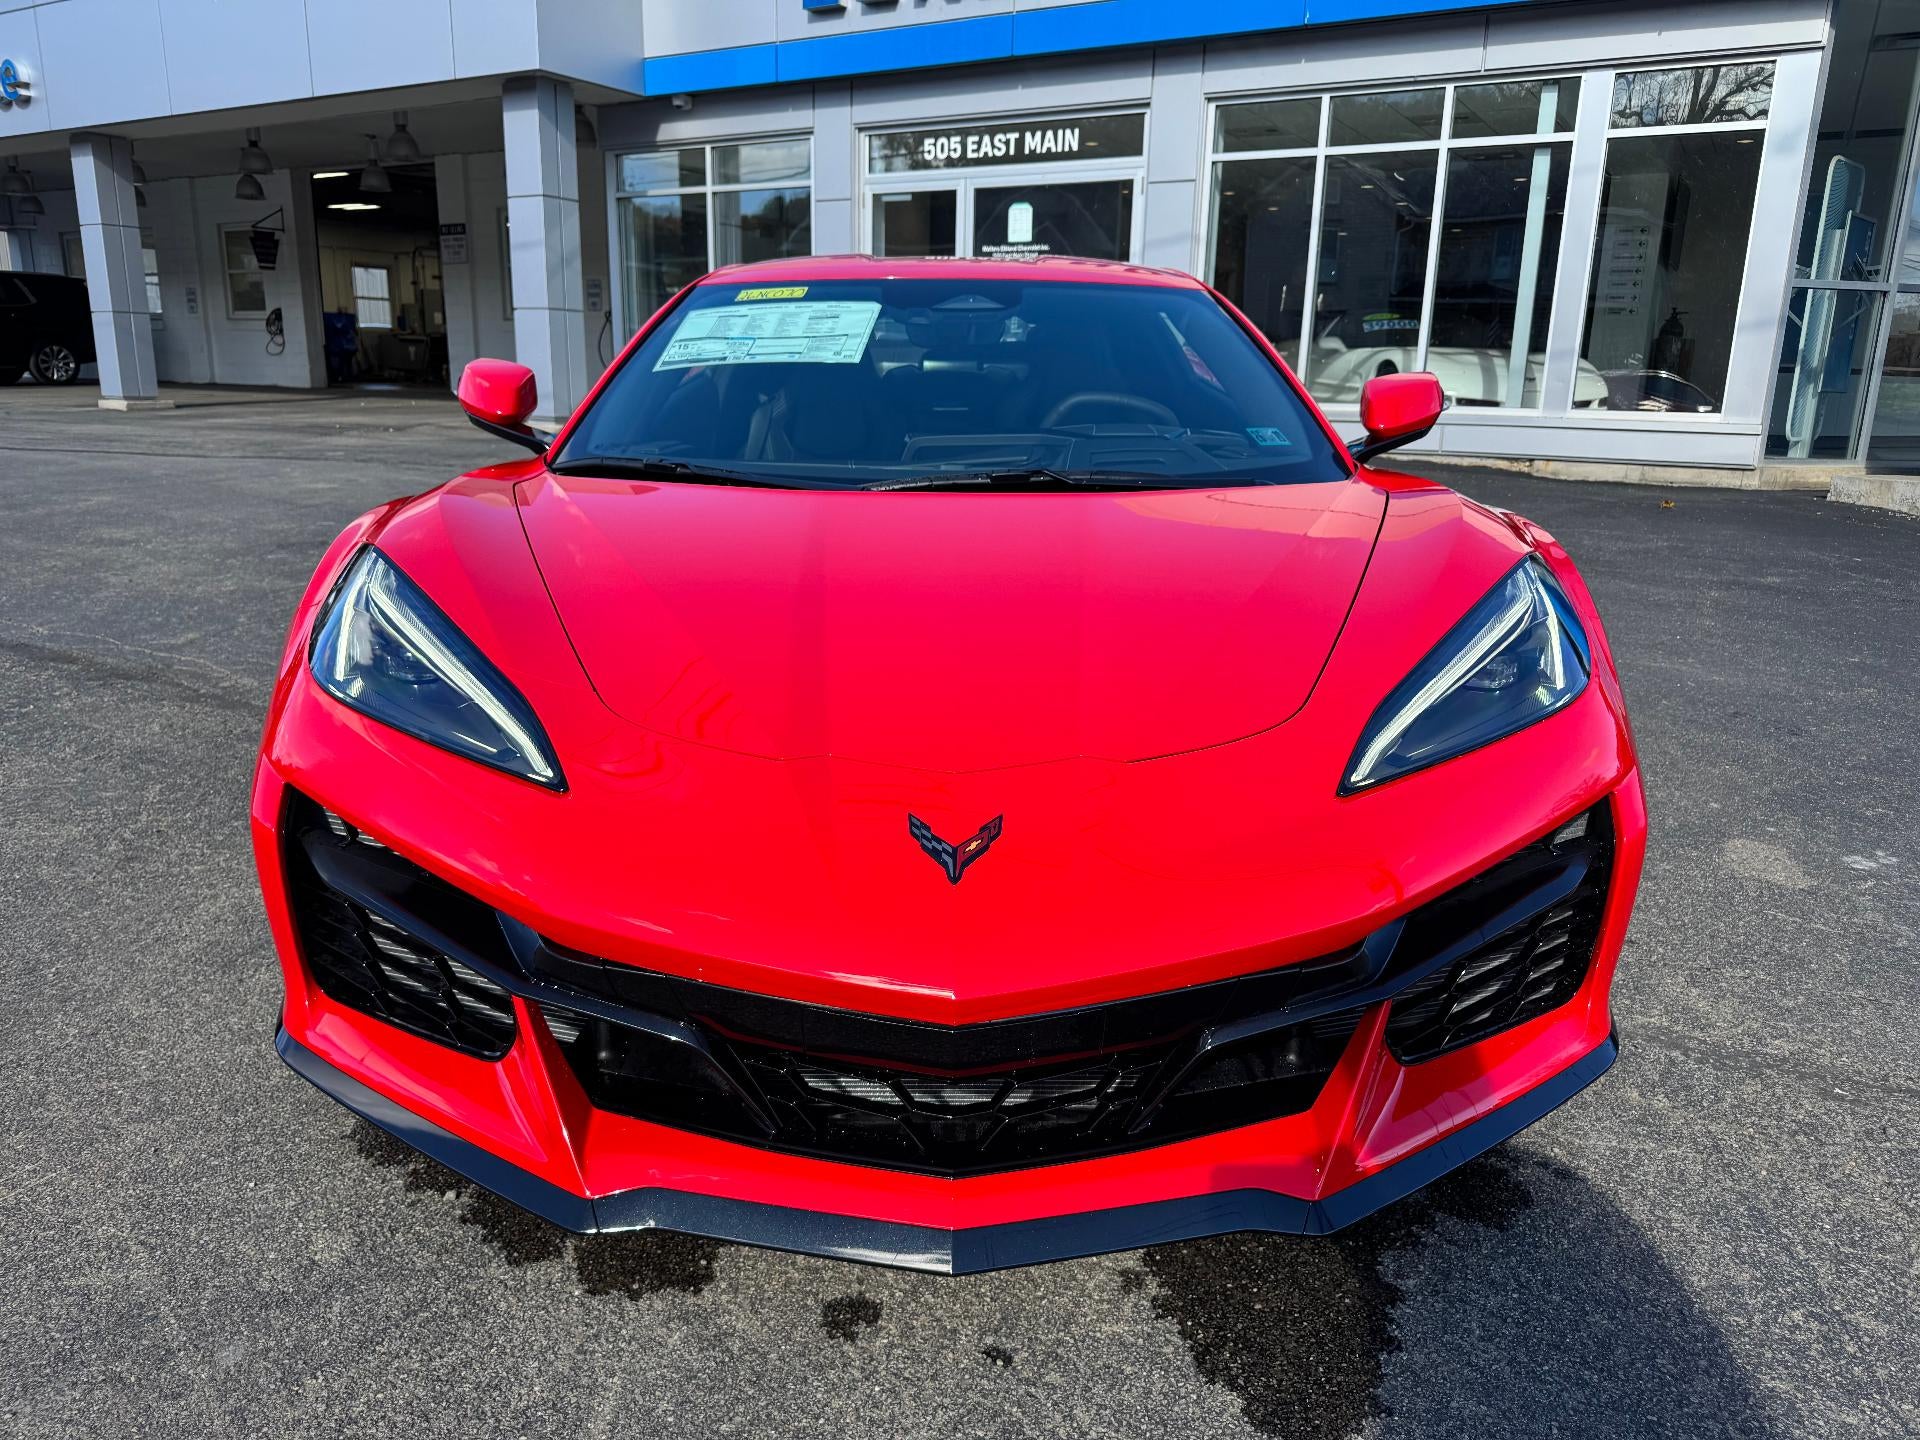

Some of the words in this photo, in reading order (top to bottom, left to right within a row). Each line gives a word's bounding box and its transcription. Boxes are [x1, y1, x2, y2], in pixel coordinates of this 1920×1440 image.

[923, 135, 962, 161] 505
[966, 132, 1020, 159] EAST
[1024, 127, 1080, 155] MAIN
